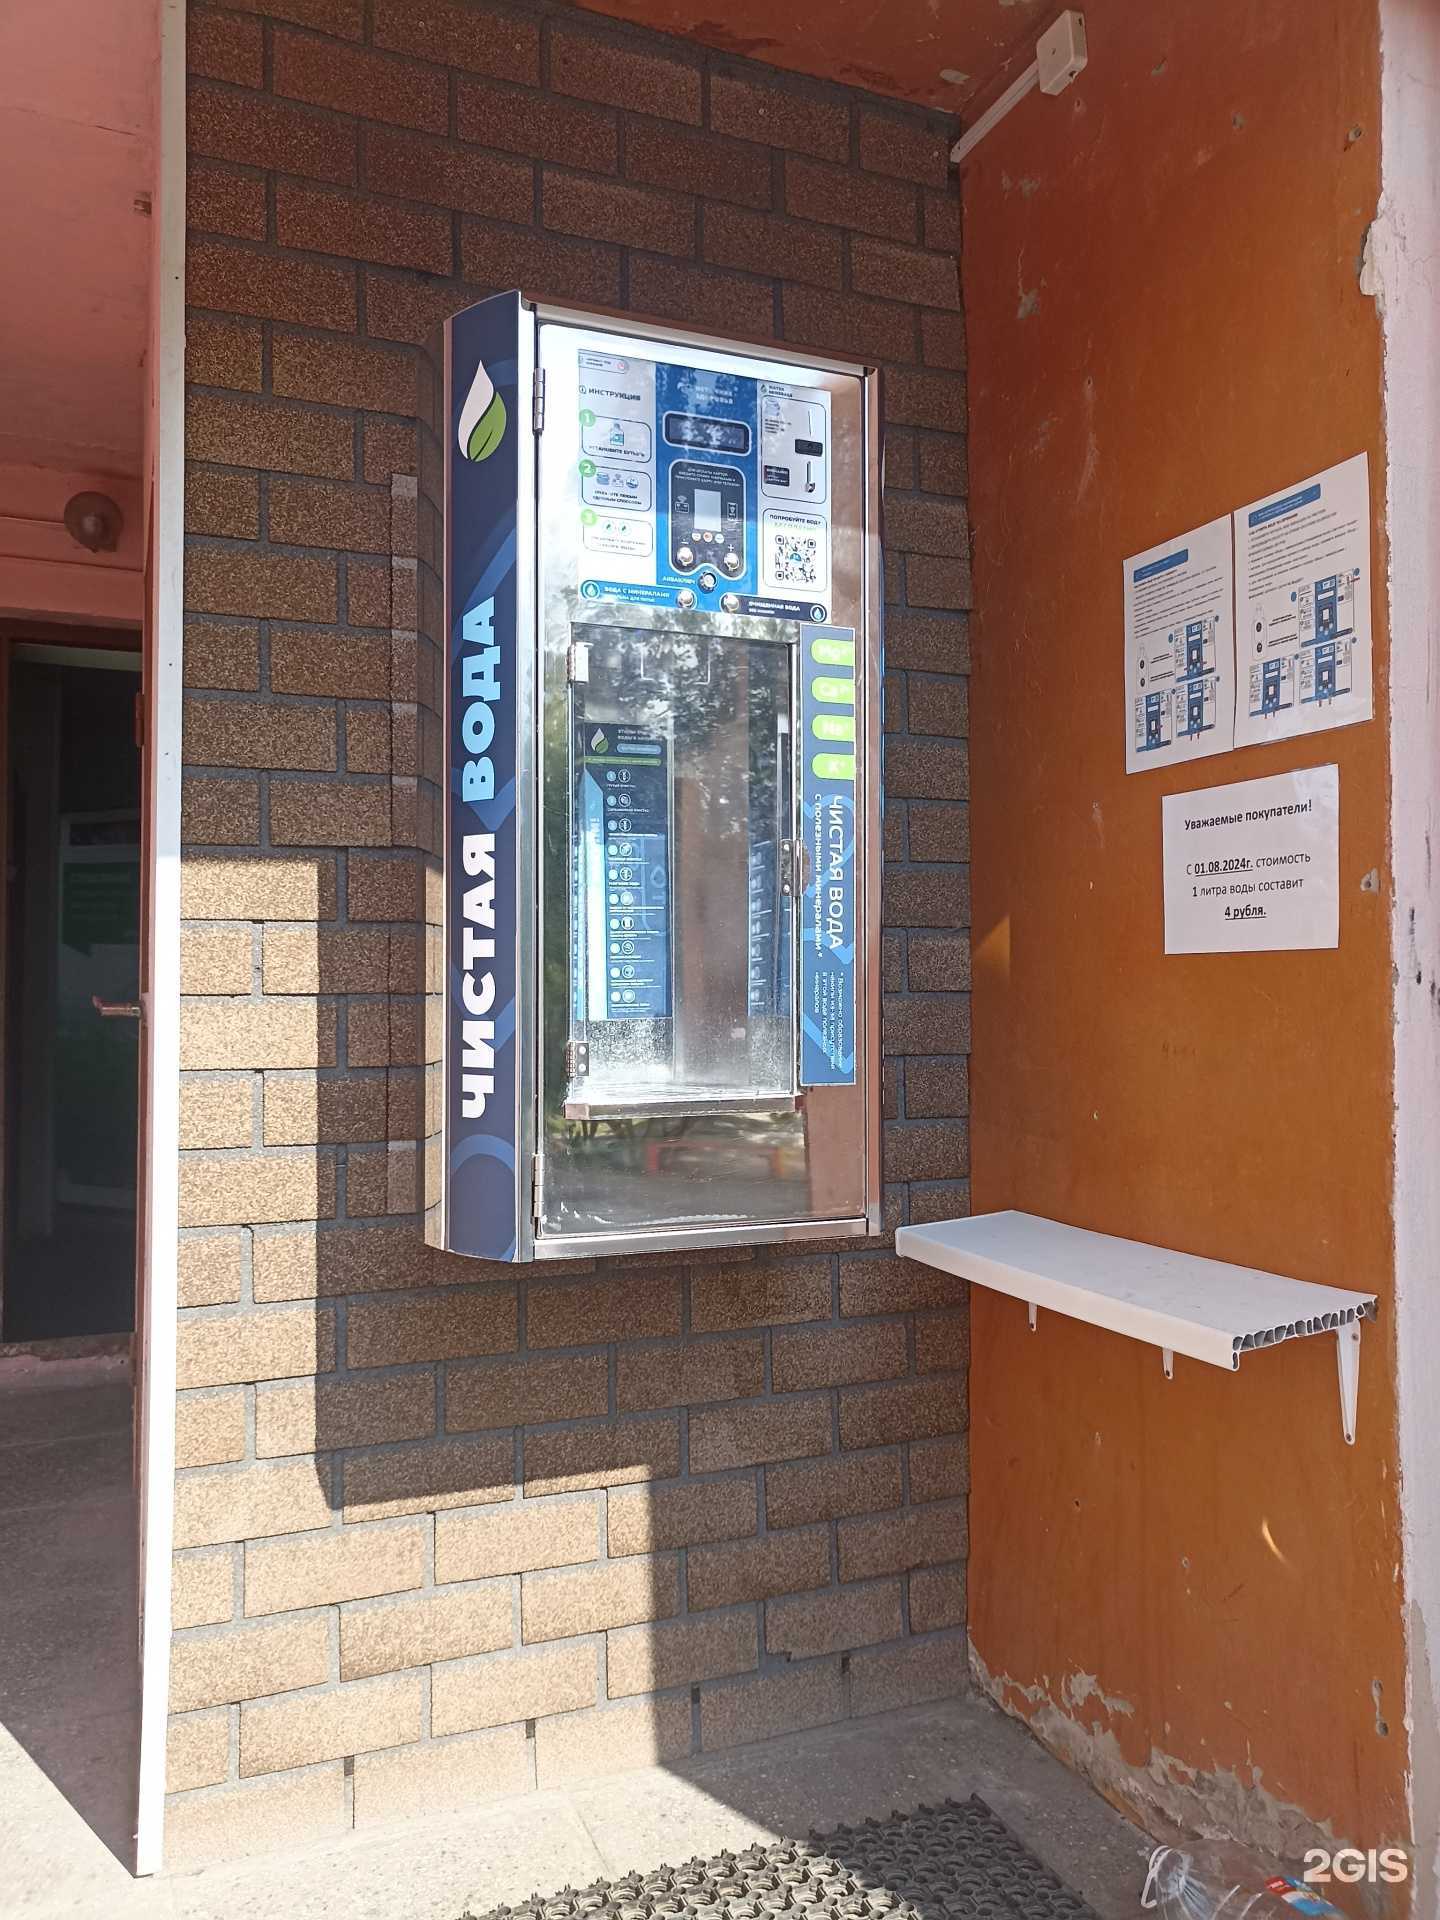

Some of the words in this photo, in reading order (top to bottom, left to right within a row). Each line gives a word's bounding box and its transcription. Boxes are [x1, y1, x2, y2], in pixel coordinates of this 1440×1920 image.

[584, 464, 592, 473] 2
[462, 597, 501, 802] ВОДА
[814, 803, 822, 872] полезными
[1184, 813, 1243, 830] Уважаемые
[1245, 799, 1312, 822] покупатели!
[828, 795, 844, 881] ЧИСТАЯ
[1194, 858, 1253, 876] 01.08.2024г.
[1256, 852, 1311, 868] стоимость
[1192, 886, 1198, 897] 1
[1200, 885, 1227, 898] литра
[1230, 882, 1255, 896] воды
[1258, 878, 1304, 892] составит
[828, 887, 844, 949] ВОДА
[1224, 906, 1231, 918] 4
[1233, 904, 1266, 920] рубля.
[462, 833, 496, 1118] ЧИСТАЯ
